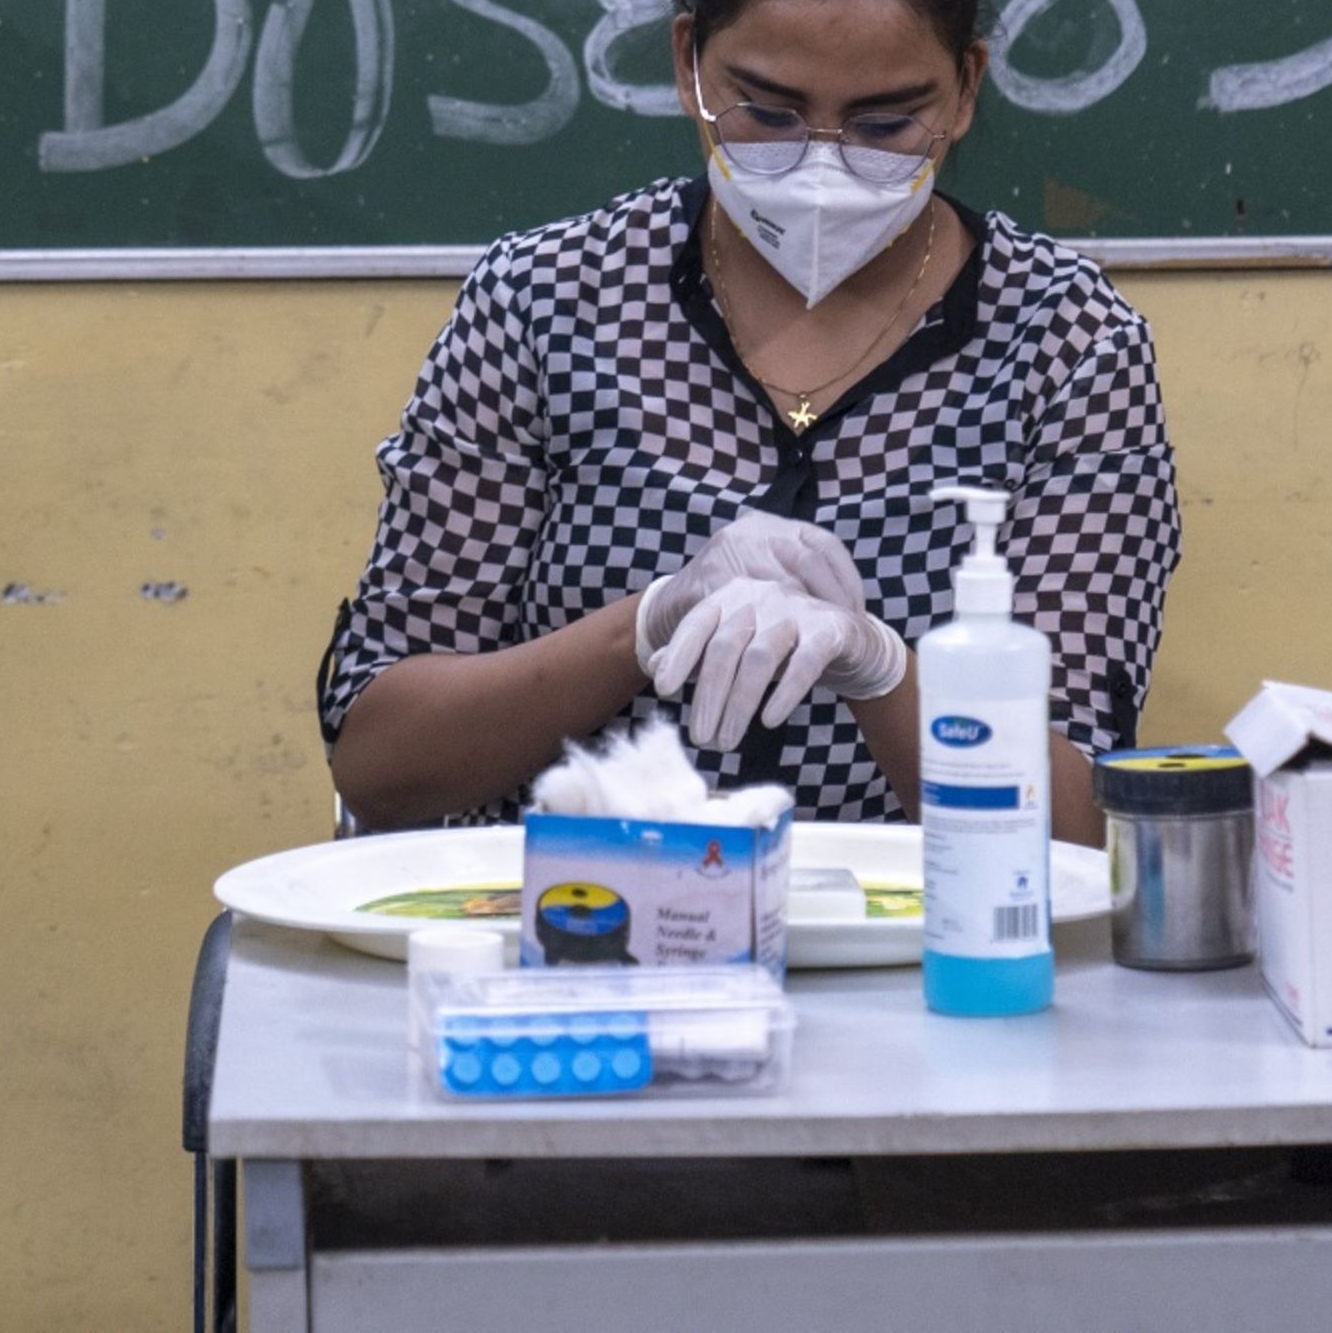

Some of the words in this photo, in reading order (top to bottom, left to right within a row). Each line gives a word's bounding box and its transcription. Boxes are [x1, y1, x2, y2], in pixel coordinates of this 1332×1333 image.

[656, 907, 711, 923] Manual
[656, 925, 703, 940] Needle
[656, 943, 708, 962] Syringe
